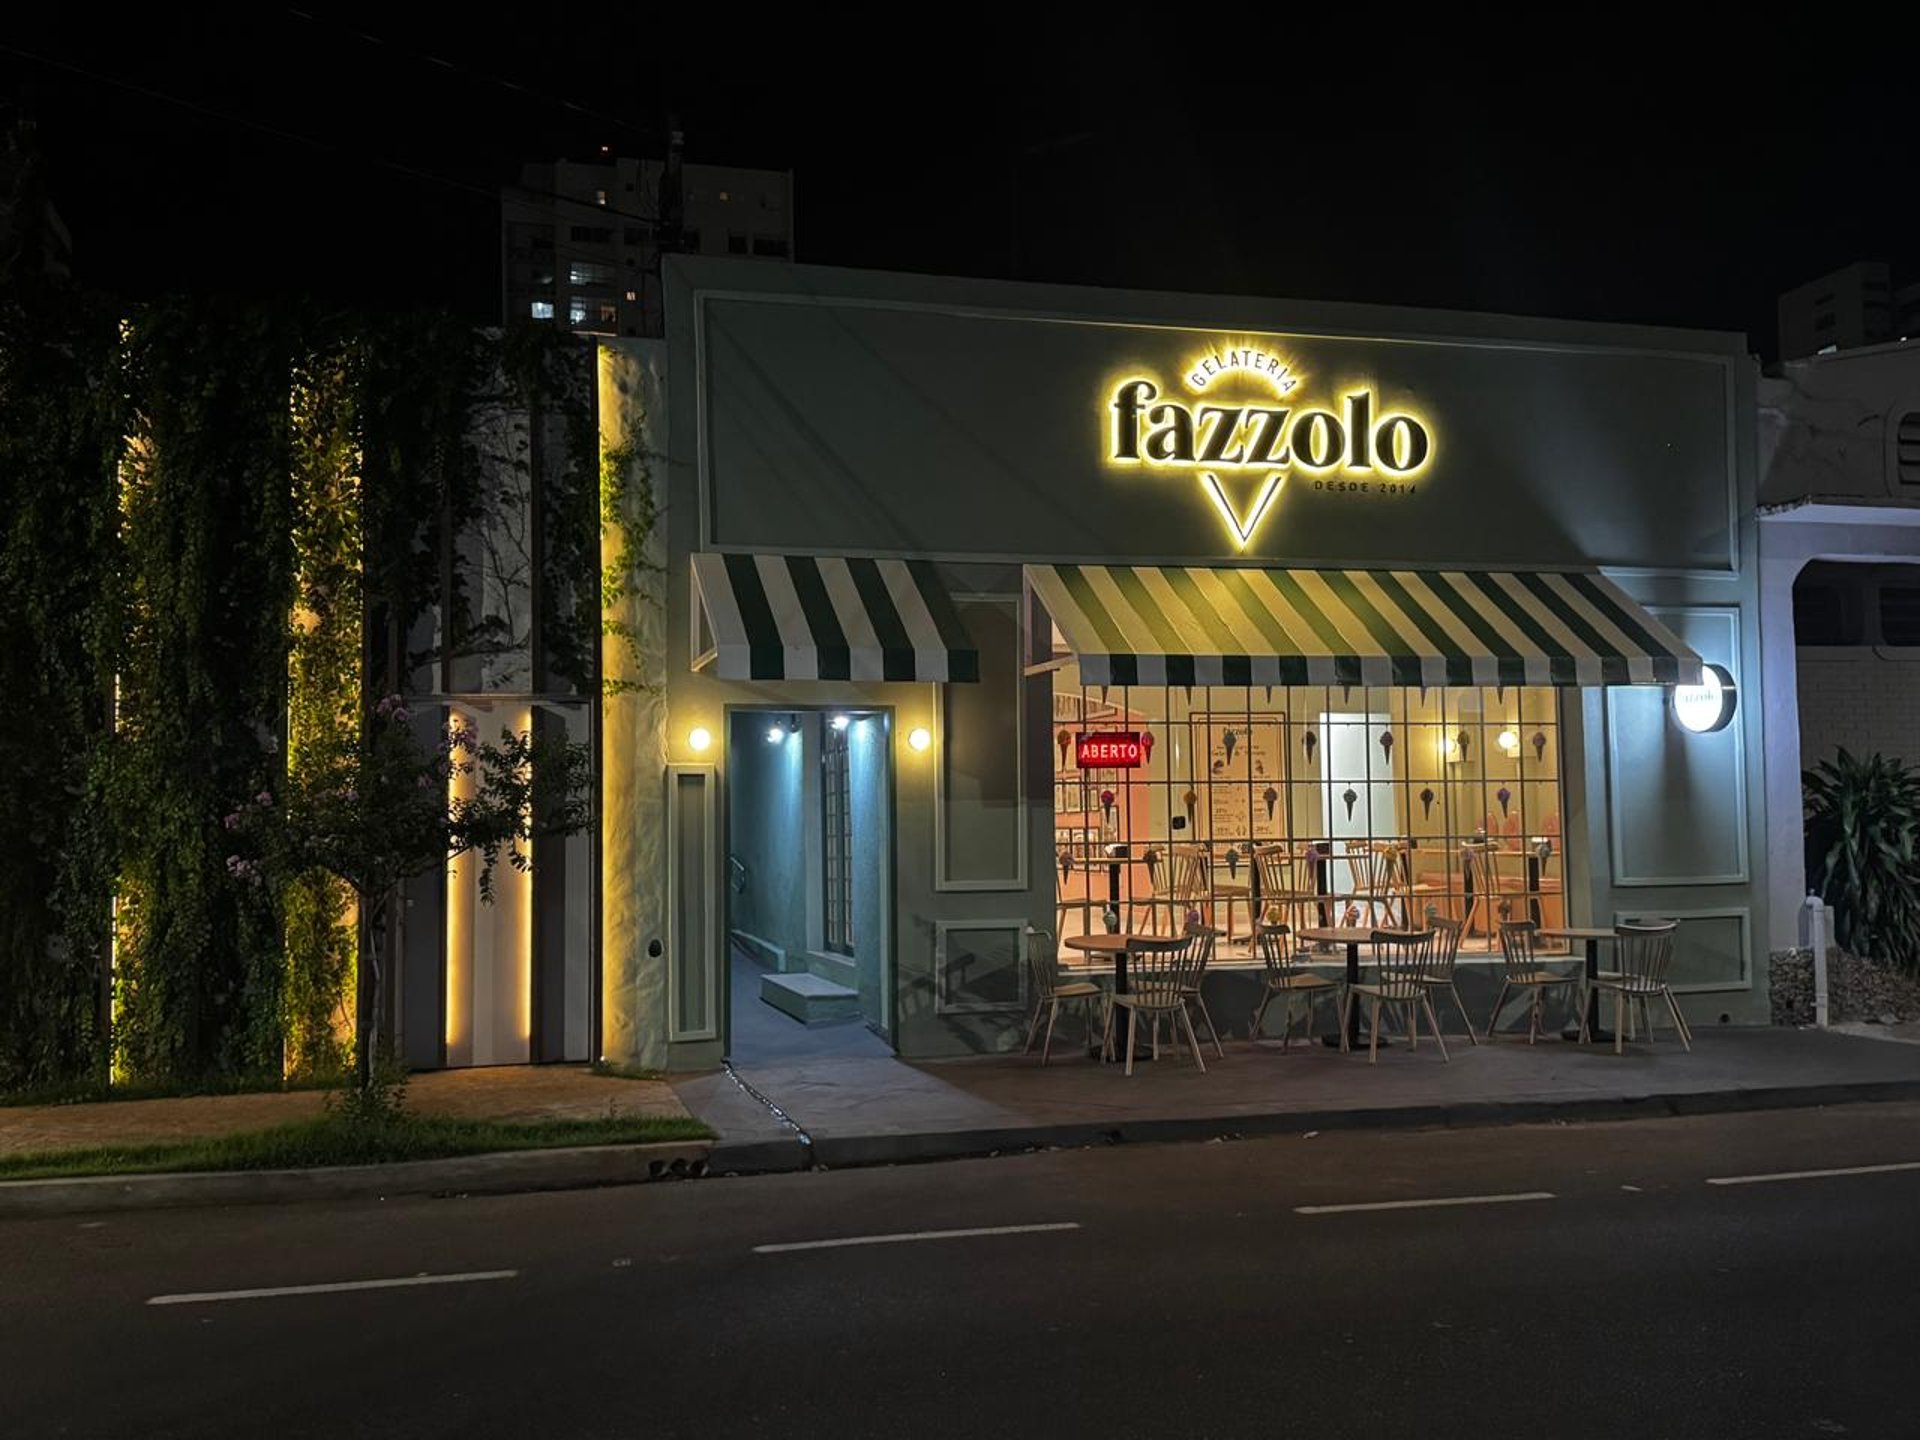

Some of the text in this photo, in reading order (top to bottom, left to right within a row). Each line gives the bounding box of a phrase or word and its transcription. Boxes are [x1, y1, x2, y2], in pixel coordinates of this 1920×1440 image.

[1192, 351, 1297, 392] GELATERIA
[1114, 380, 1428, 471] fazzolo
[1314, 480, 1416, 494] DESDE 2014
[1082, 744, 1138, 758] ABERTO
